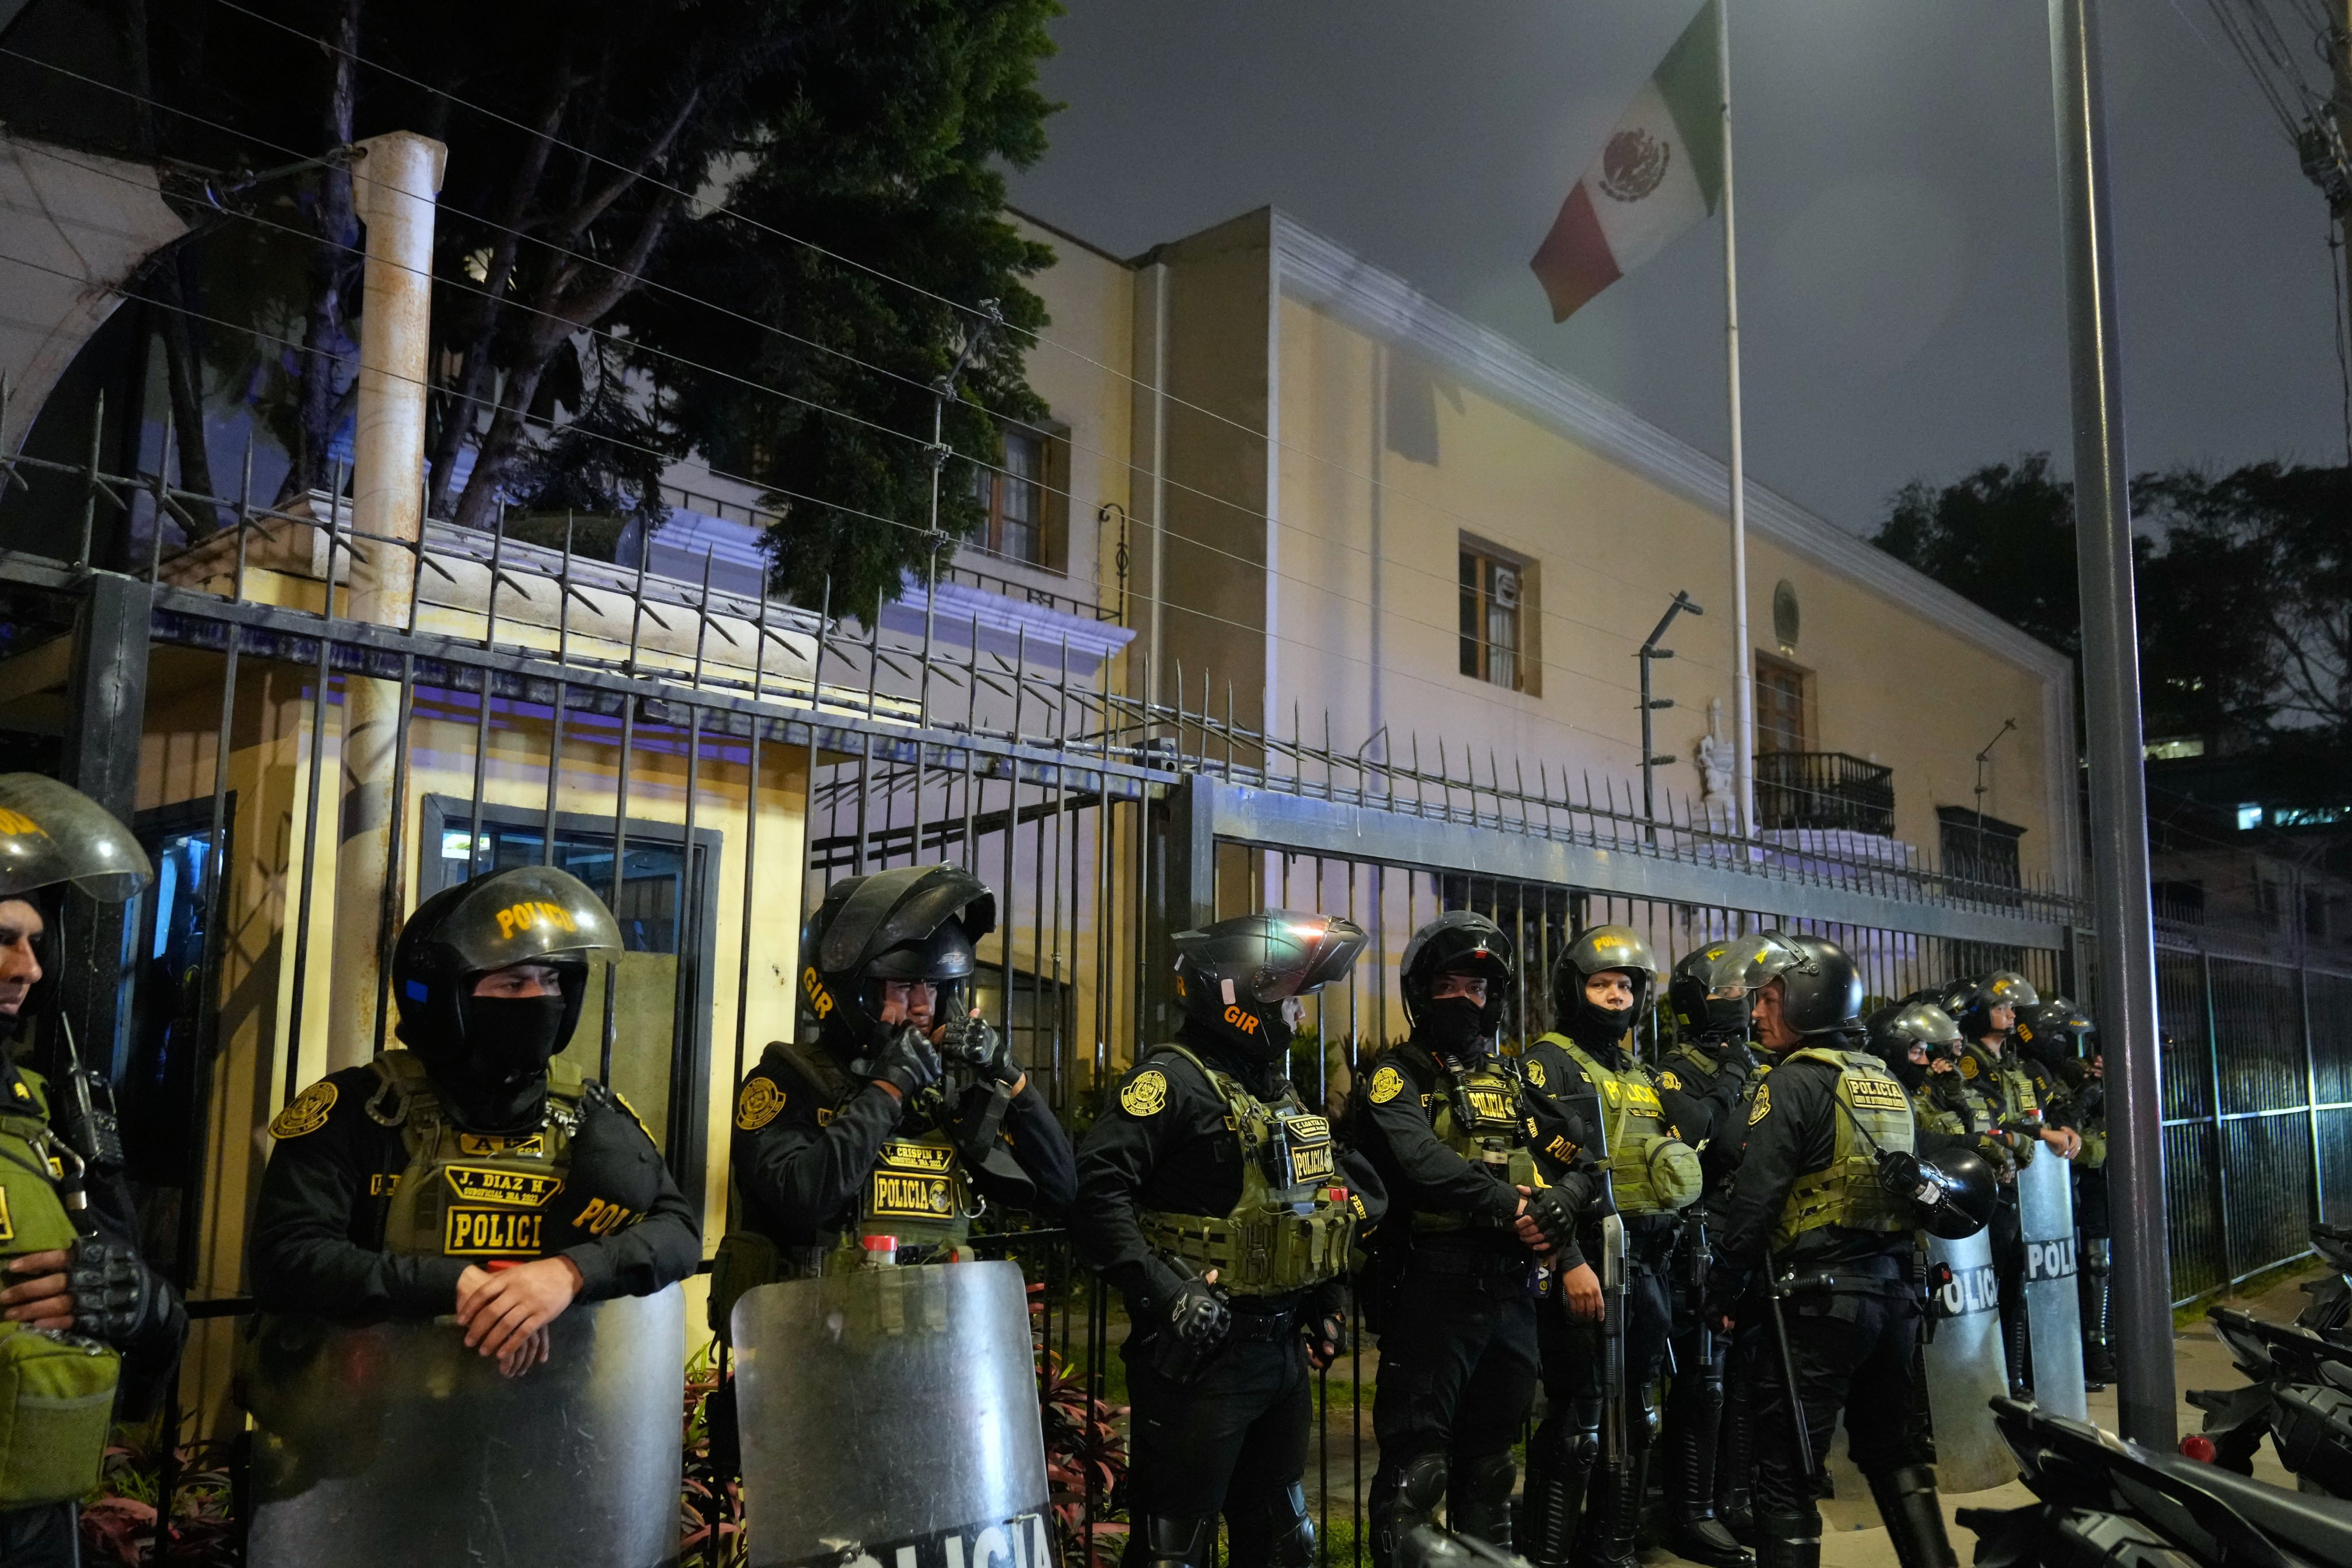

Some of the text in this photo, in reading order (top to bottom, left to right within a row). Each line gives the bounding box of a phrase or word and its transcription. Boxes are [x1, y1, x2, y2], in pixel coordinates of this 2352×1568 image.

[804, 967, 833, 1019] GIR
[1224, 1006, 1259, 1035] GIR
[2017, 1023, 2034, 1043] GIR
[1849, 1080, 1902, 1097] POLICIA
[1469, 1092, 1507, 1119] POLICIA
[1526, 1116, 1539, 1138] PERU
[1670, 1125, 1682, 1141] PERU
[885, 1146, 944, 1160] Y. CRISPIN P.
[1295, 1149, 1324, 1177] POLICIA
[459, 1172, 546, 1194] J. DIAZ H.
[878, 1178, 929, 1210] POLICIA
[1350, 1194, 1367, 1220] PERU
[454, 1214, 543, 1248] POLICI
